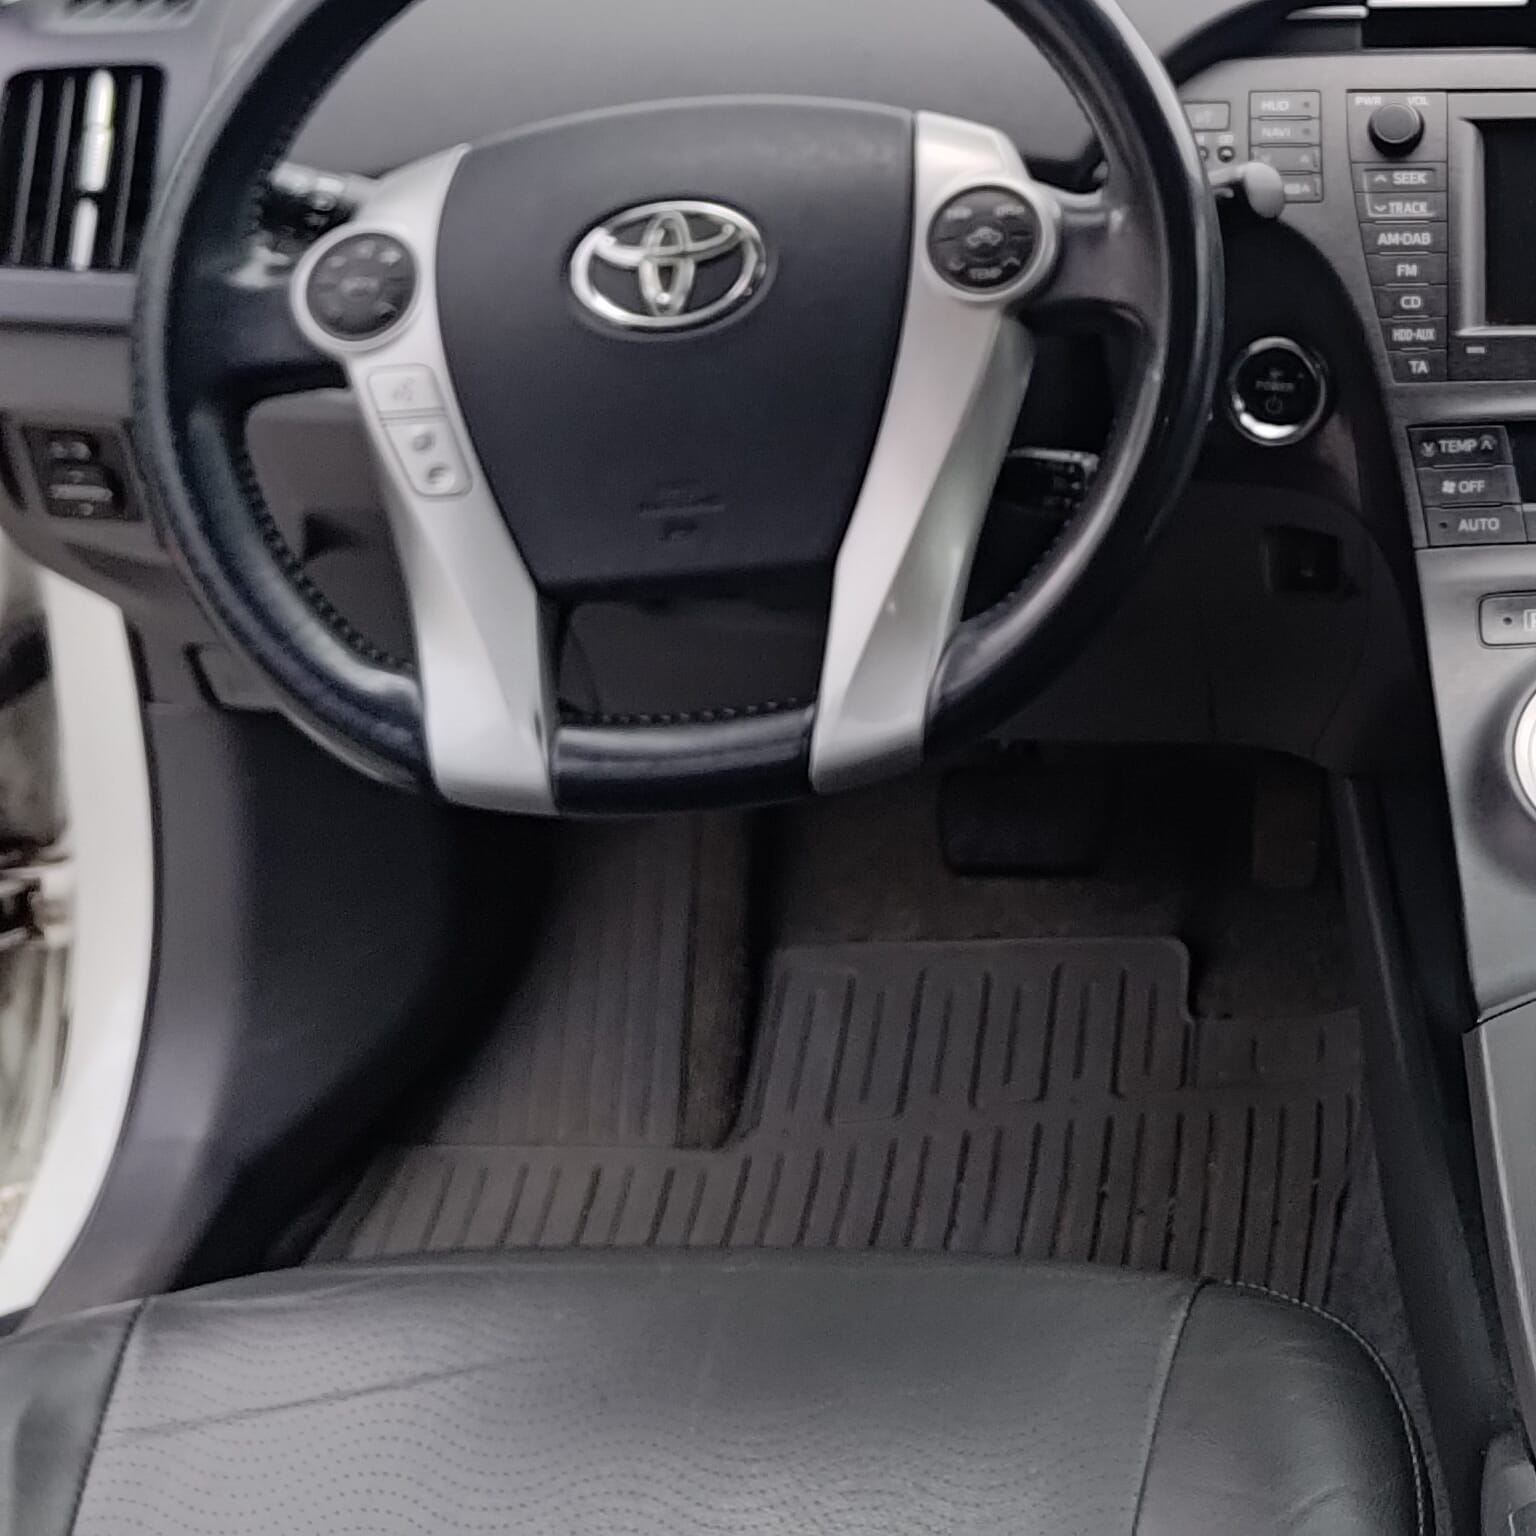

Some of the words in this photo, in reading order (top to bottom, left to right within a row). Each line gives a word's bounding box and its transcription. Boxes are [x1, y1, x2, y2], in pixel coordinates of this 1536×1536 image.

[1407, 96, 1430, 107] VOL
[1392, 171, 1428, 185] SEEK
[1388, 201, 1429, 214] TRACK
[1396, 264, 1419, 277] FM
[1400, 295, 1423, 309] CD
[1408, 360, 1429, 374] TA
[1438, 438, 1478, 453] TEMP
[1458, 479, 1486, 494] OFF
[1458, 517, 1500, 532] AUTO
